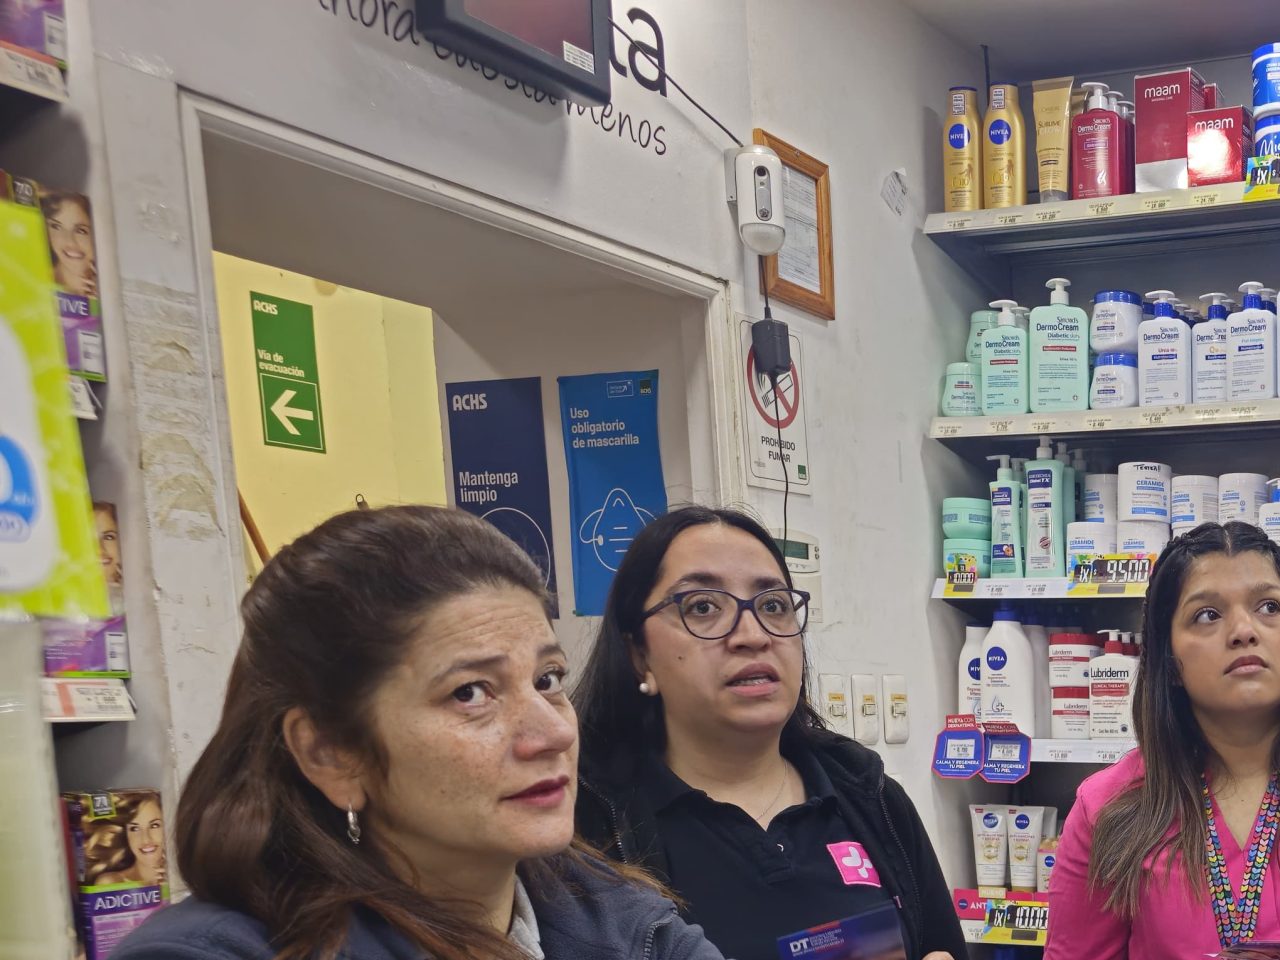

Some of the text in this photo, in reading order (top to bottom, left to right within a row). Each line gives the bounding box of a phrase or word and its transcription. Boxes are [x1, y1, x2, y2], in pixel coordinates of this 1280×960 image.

[1144, 83, 1181, 99] maam
[452, 393, 488, 411] ACHS
[570, 407, 589, 419] Uso
[571, 421, 626, 435] obligatorio
[572, 433, 640, 449] de mascarilla
[459, 471, 519, 487] Mantenga
[1136, 480, 1165, 488] CERAMIDE
[461, 488, 498, 505] limpio
[1090, 667, 1130, 678] Lubriderm
[94, 889, 161, 911] ADICTIVE
[789, 937, 810, 953] DT
